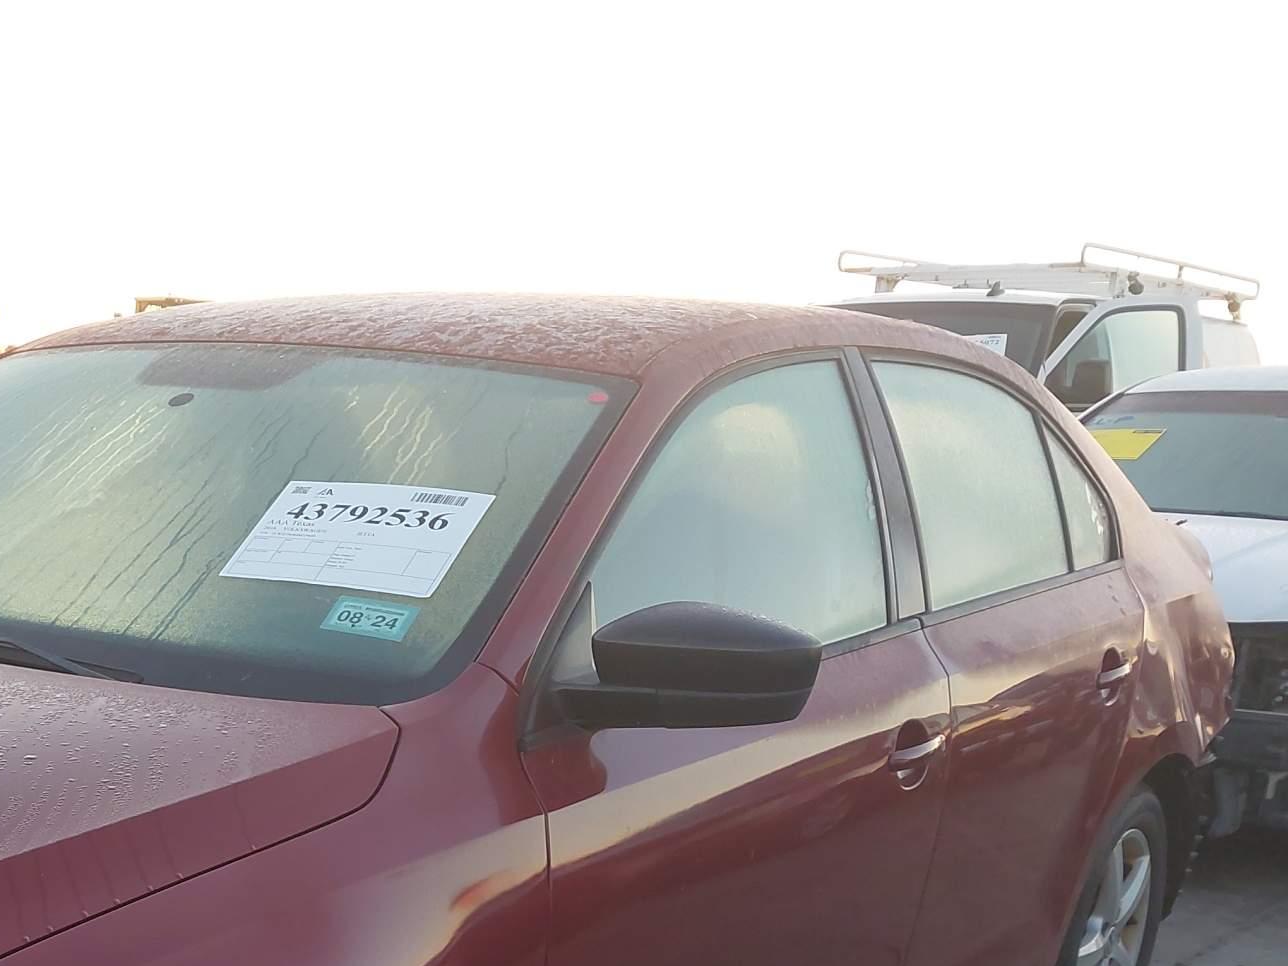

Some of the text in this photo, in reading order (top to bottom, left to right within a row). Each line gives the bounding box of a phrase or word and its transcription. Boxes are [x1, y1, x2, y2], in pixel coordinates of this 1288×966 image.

[286, 501, 456, 531] 43792536
[337, 610, 364, 624] 08
[370, 615, 399, 630] 24
